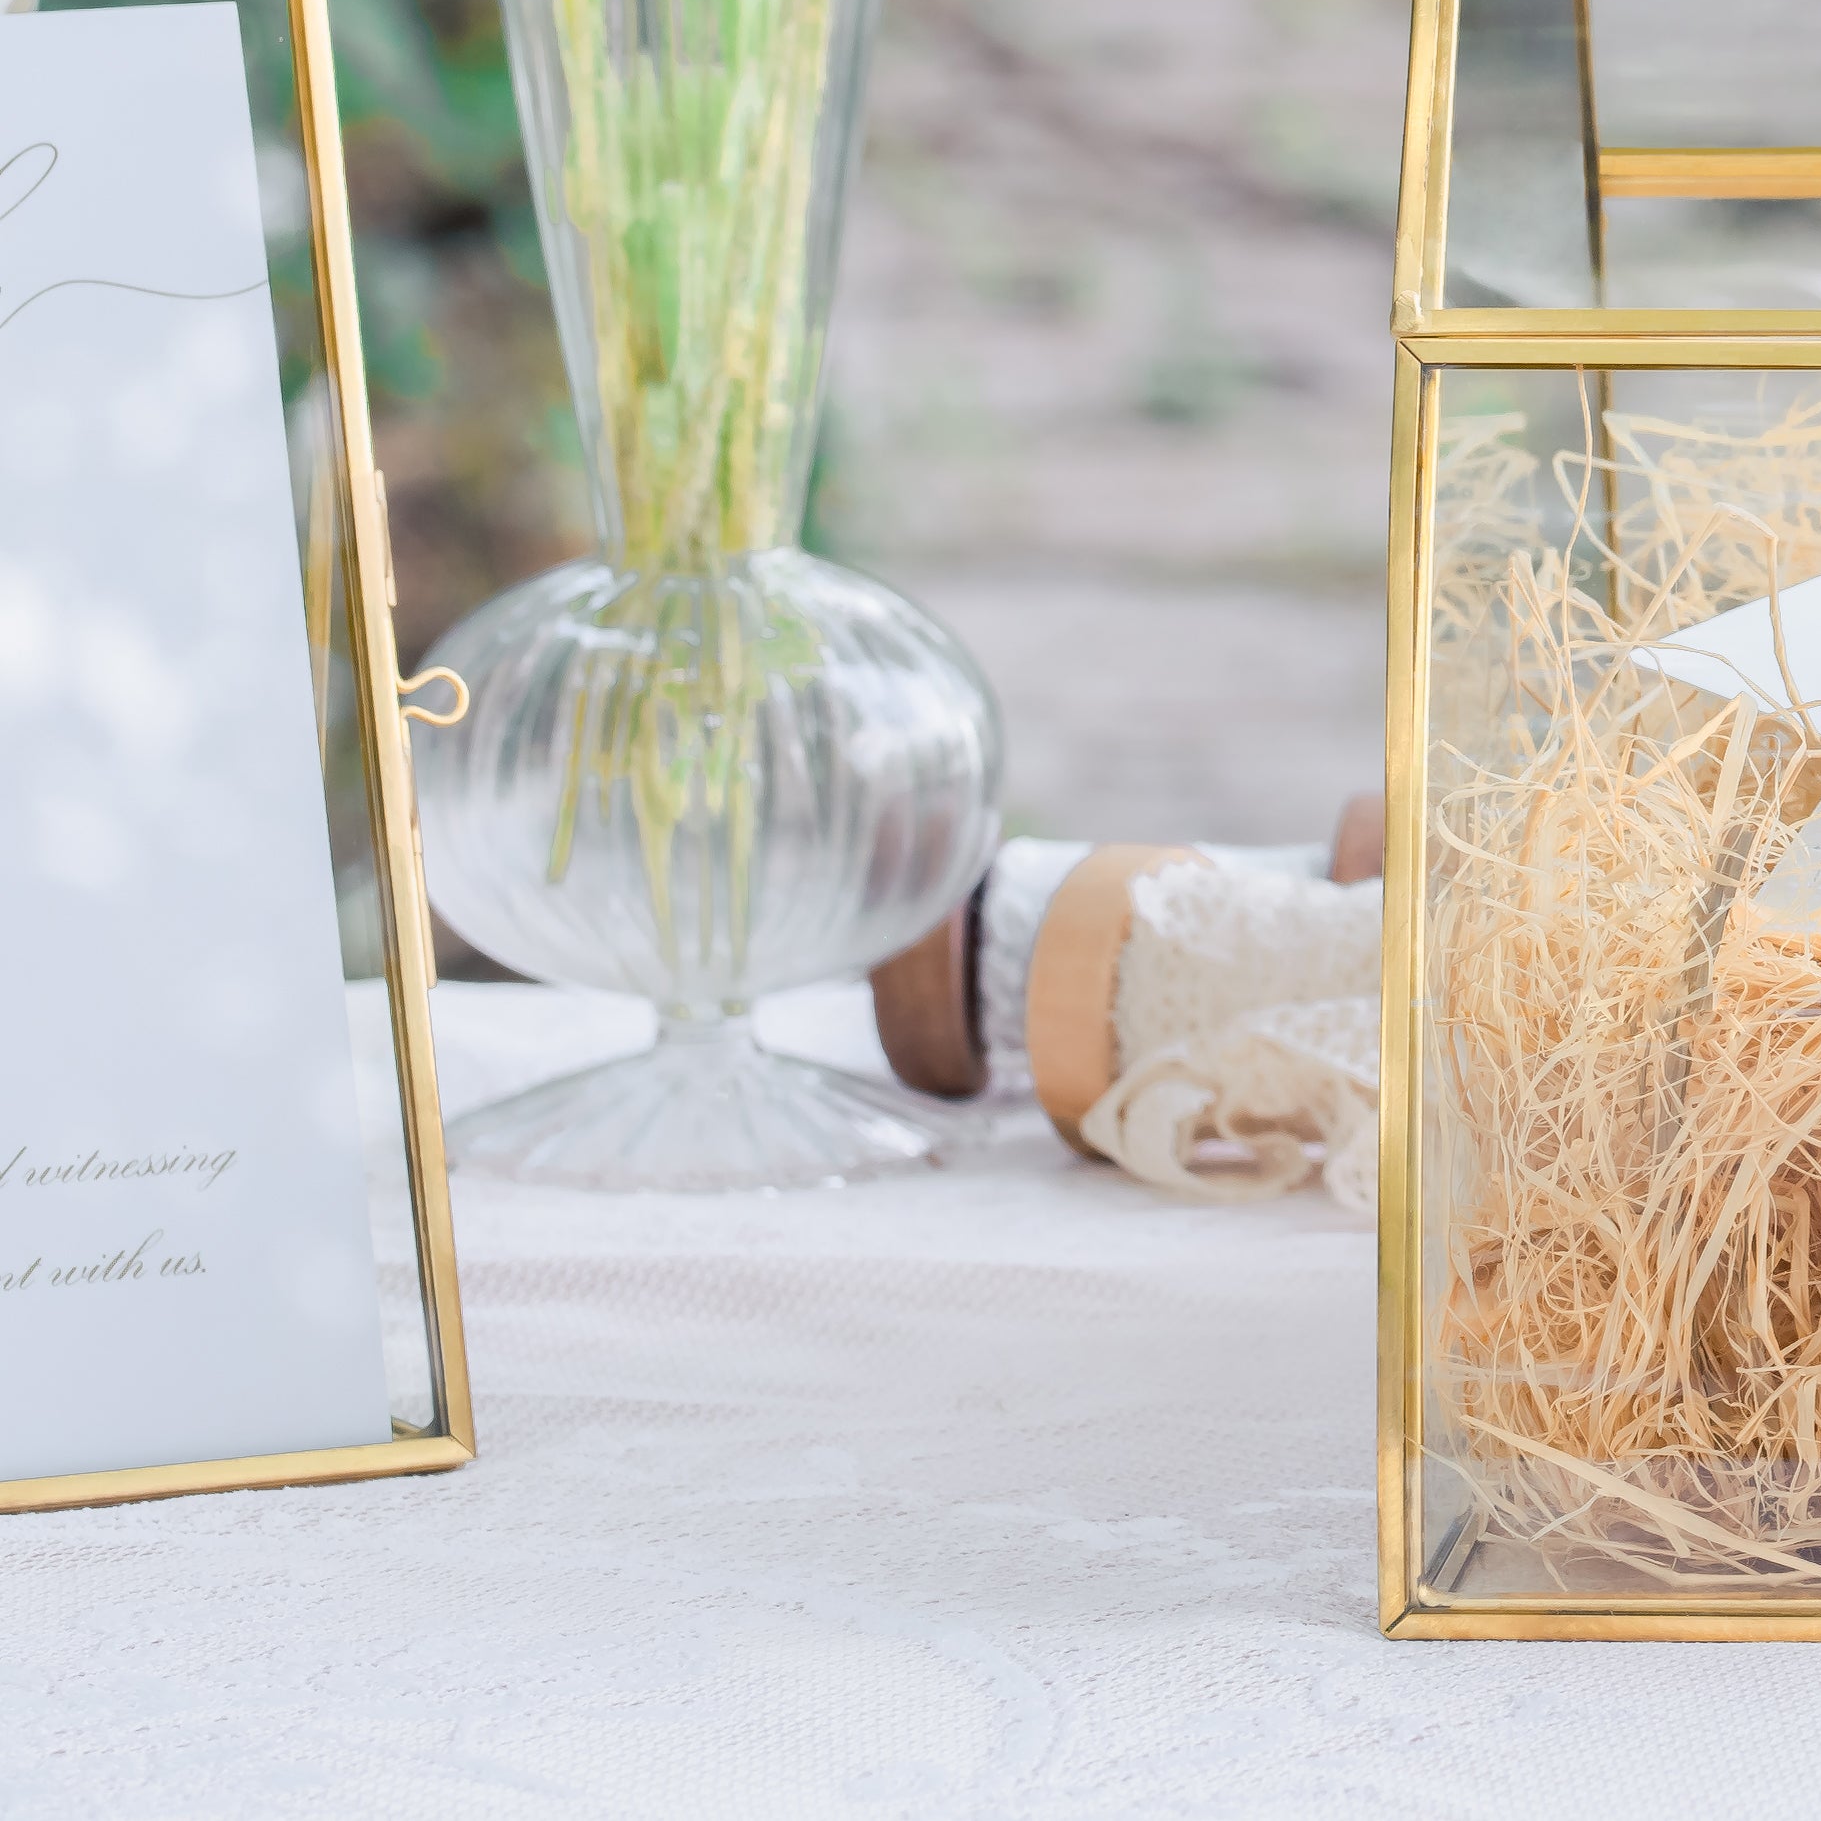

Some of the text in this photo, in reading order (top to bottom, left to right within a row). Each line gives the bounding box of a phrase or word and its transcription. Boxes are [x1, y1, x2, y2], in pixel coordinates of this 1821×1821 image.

[25, 1144, 238, 1192] witnessing
[51, 1228, 164, 1288] with
[160, 1249, 207, 1278] us.
